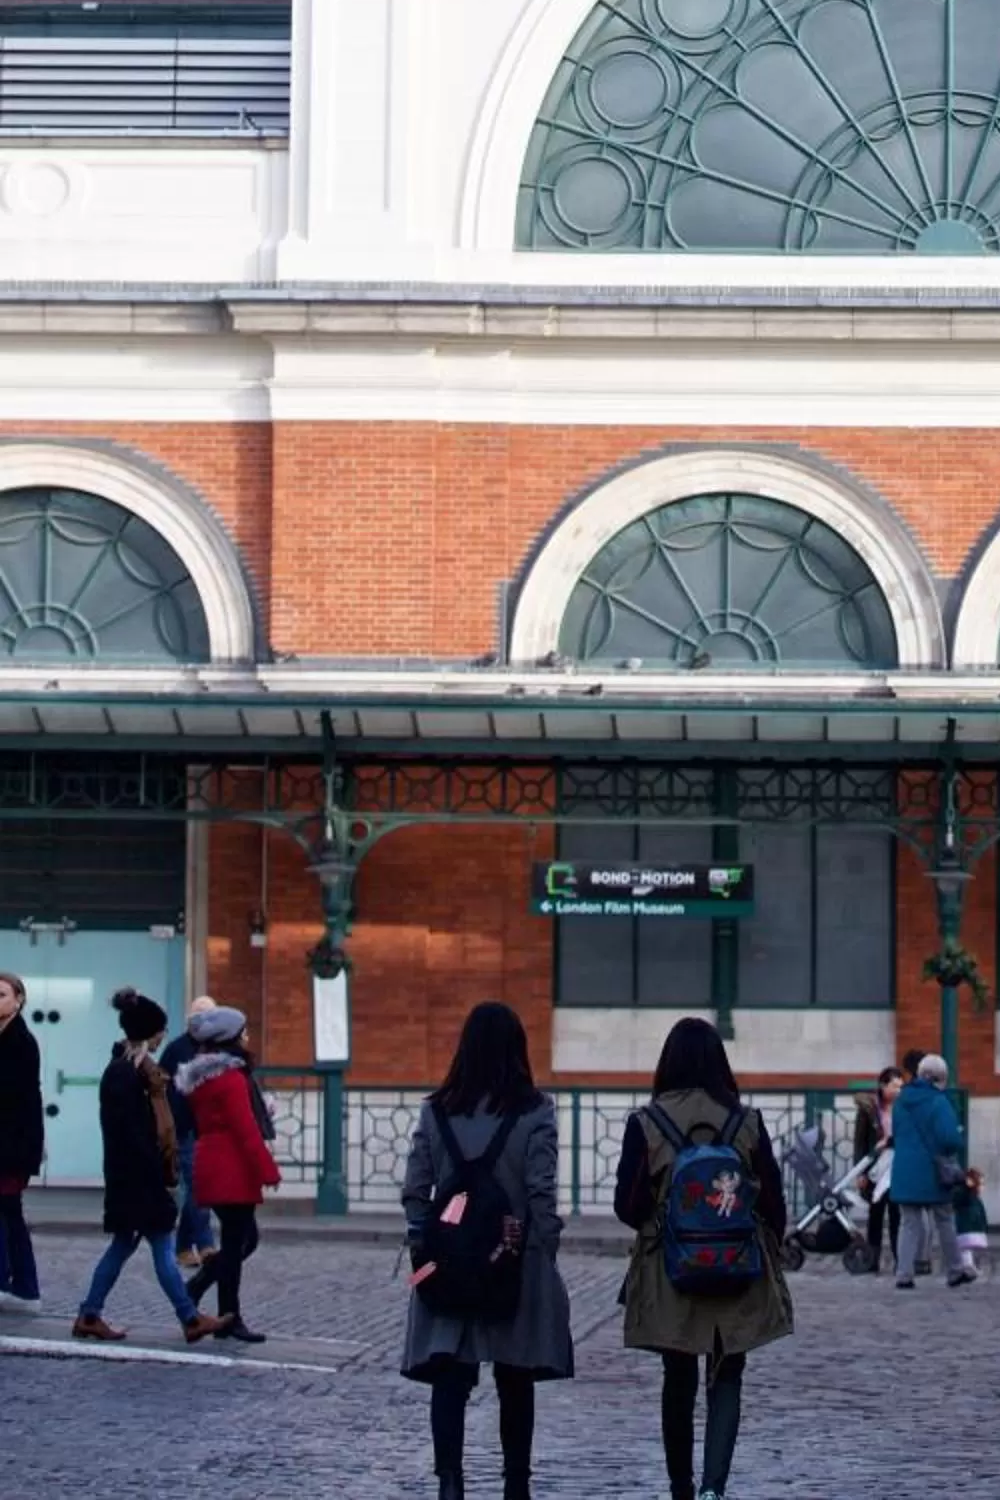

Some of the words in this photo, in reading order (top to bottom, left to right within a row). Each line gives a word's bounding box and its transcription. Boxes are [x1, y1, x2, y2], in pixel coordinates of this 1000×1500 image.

[591, 871, 631, 885] BOND
[640, 871, 696, 885] MOTION
[556, 901, 602, 915] London
[604, 901, 630, 915] Film
[633, 902, 685, 915] Museum
